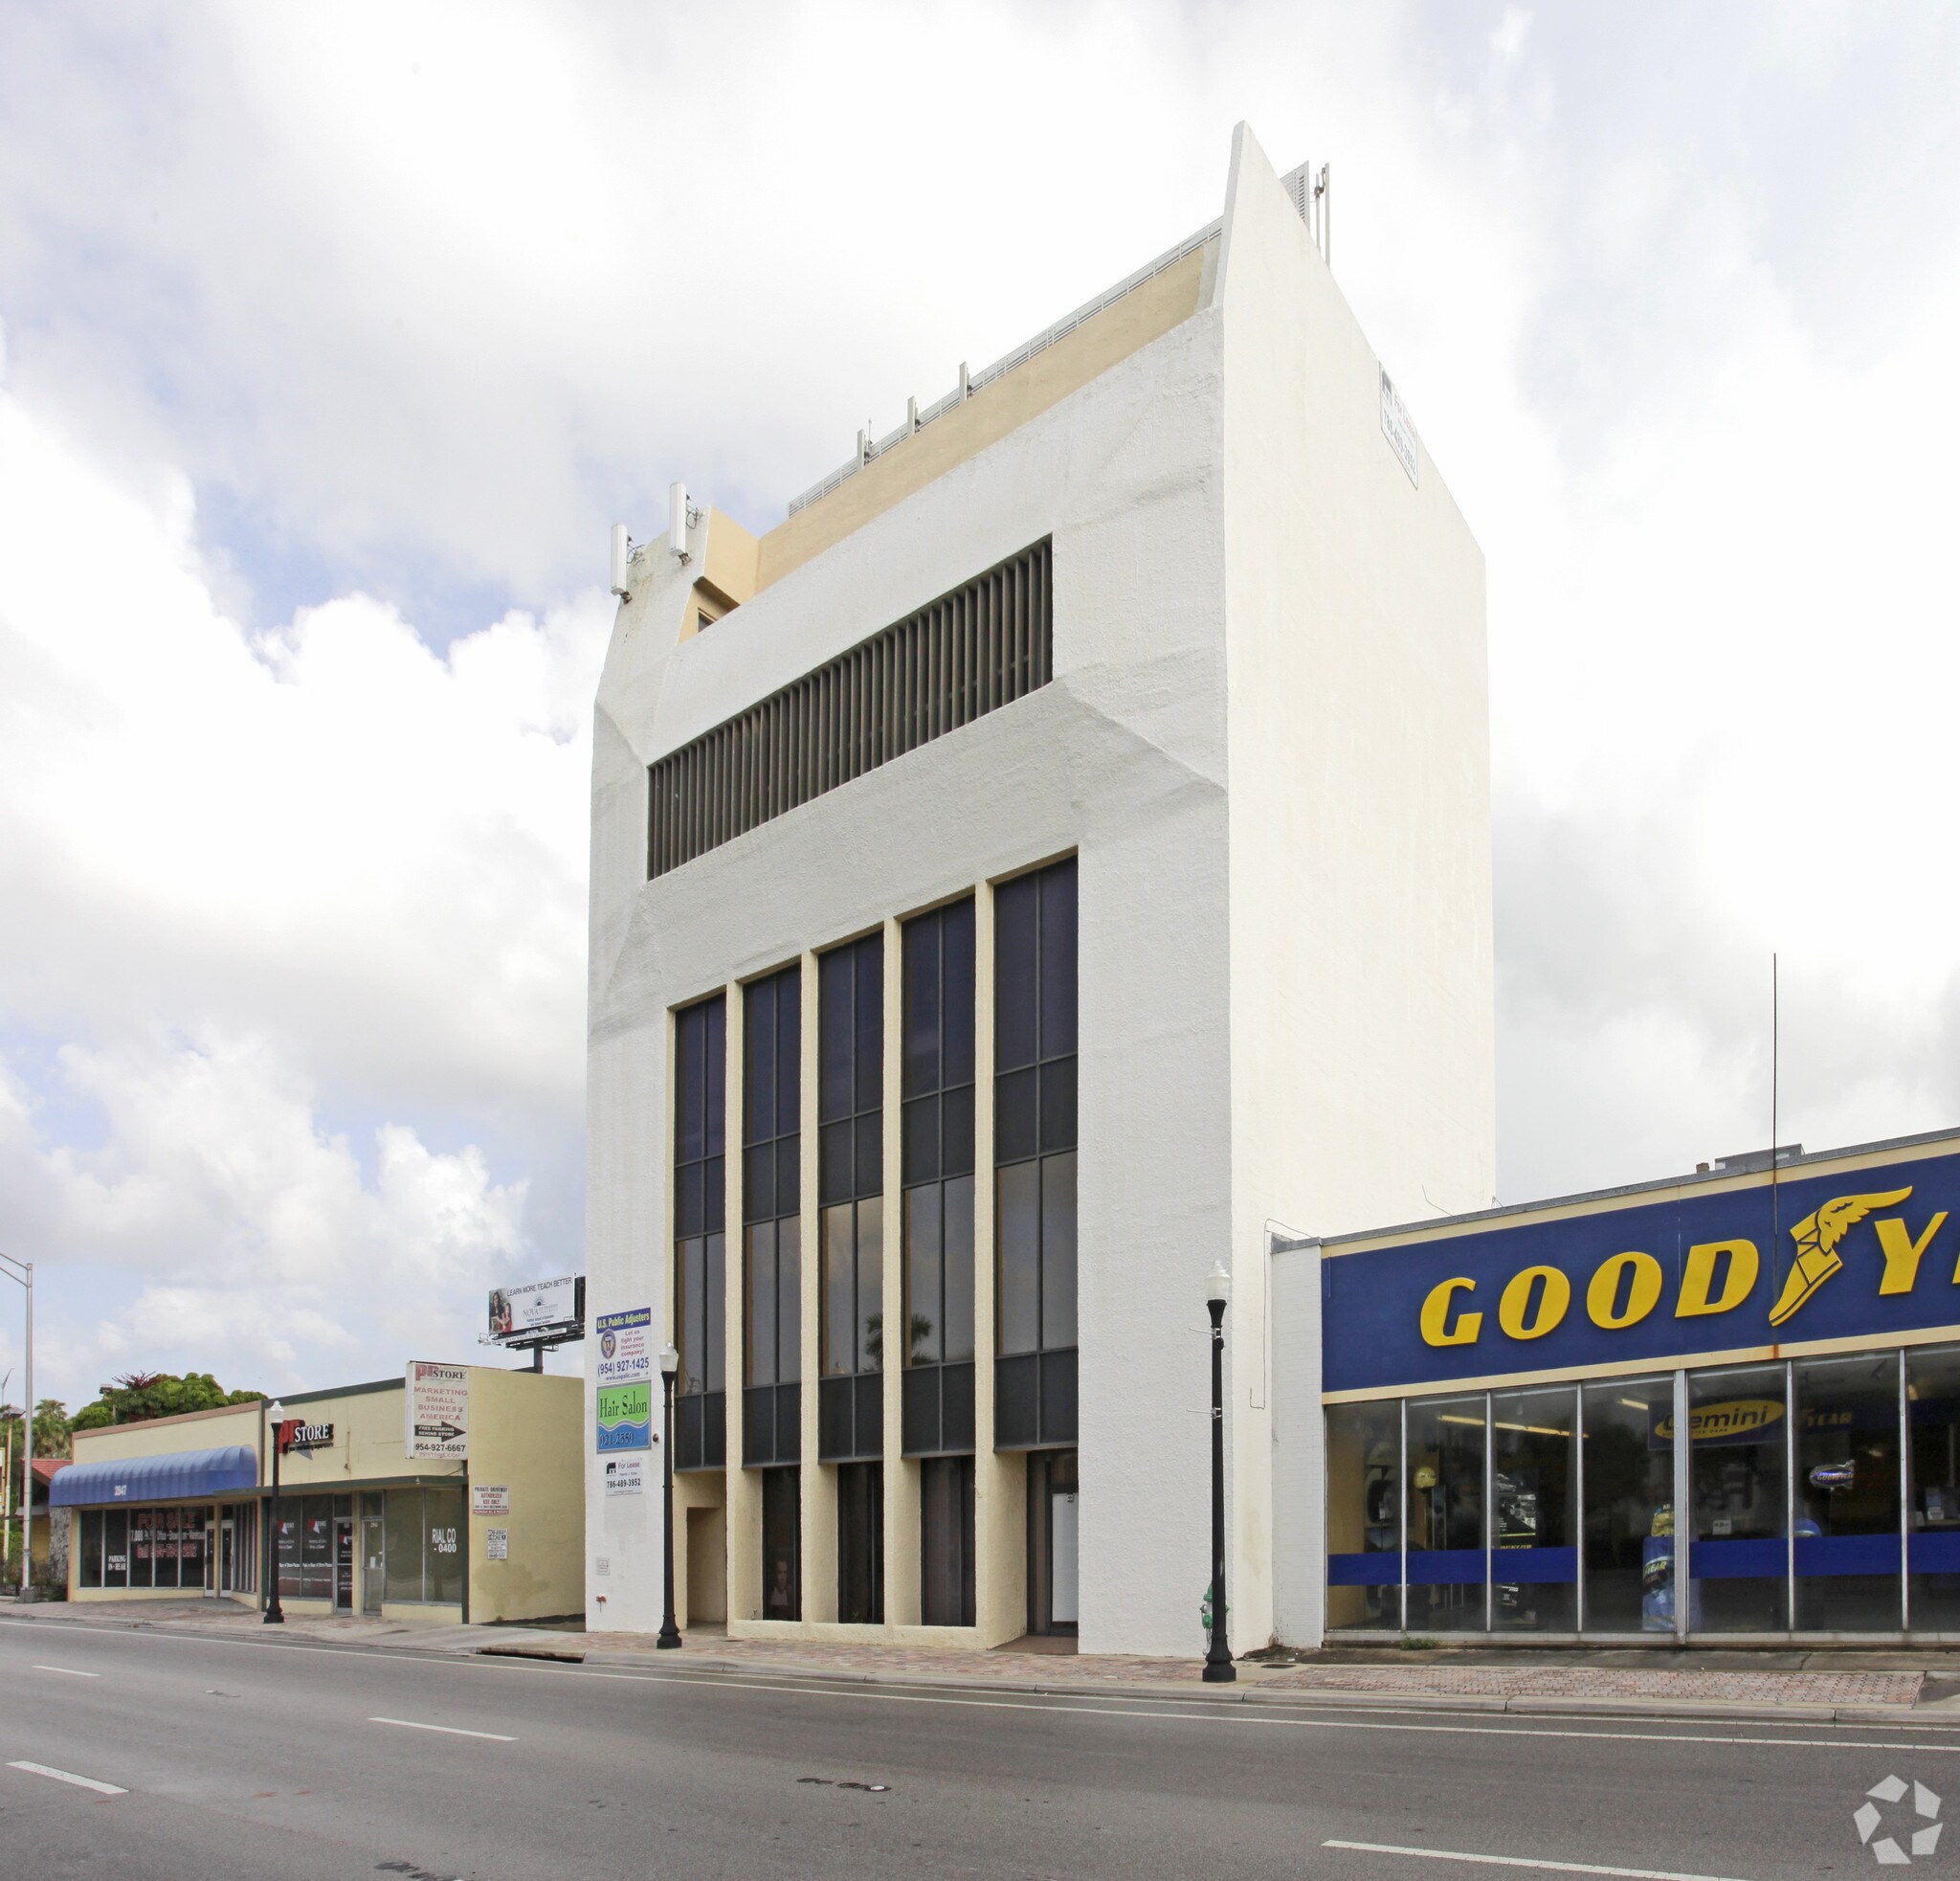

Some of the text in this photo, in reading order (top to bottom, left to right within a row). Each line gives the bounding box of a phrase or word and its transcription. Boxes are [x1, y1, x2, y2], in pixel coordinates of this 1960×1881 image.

[507, 1277, 572, 1297] LEARN MORE TEACH BETTER
[597, 1312, 650, 1329] U.S. Public Adjusters
[597, 1357, 650, 1377] (954) 927-1425
[414, 1386, 468, 1396] MARKETING
[425, 1396, 456, 1404] SMALL
[600, 1391, 648, 1418] Hair Salon
[418, 1404, 463, 1413] BUSINESS
[295, 1423, 329, 1443] STORE
[415, 1443, 466, 1452] 954-927-6667
[447, 1528, 457, 1543] CO
[438, 1543, 457, 1553] 0400
[108, 1555, 126, 1563] PARKING
